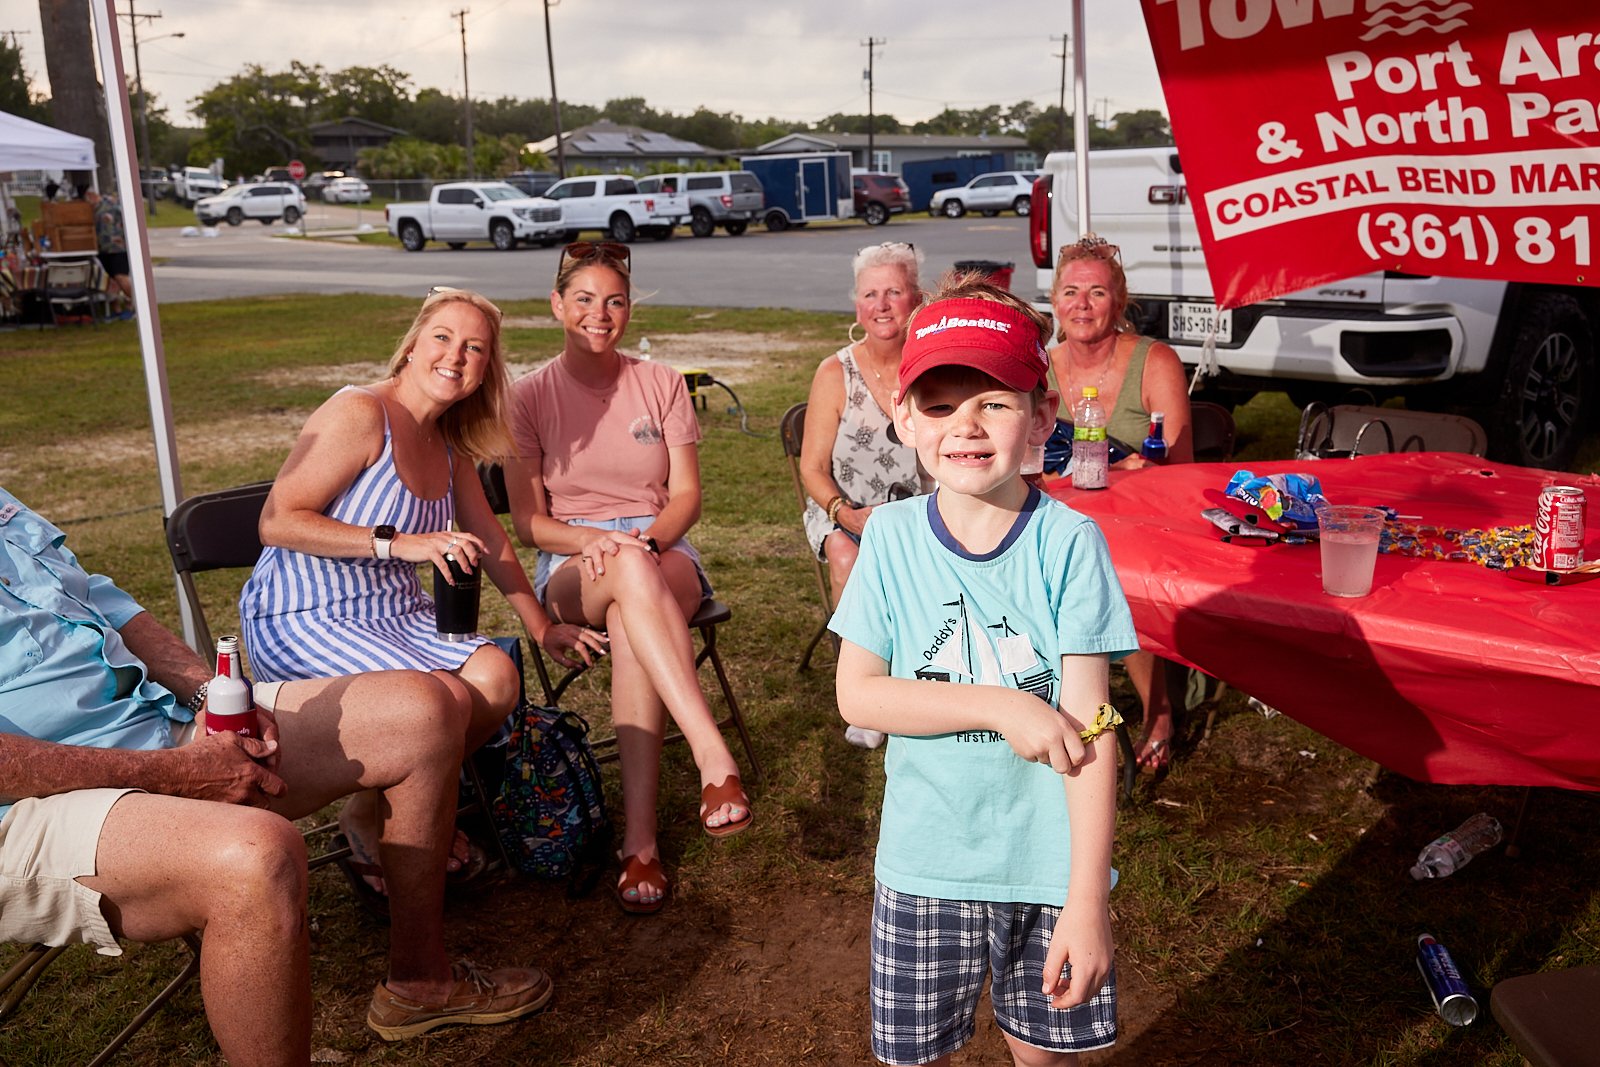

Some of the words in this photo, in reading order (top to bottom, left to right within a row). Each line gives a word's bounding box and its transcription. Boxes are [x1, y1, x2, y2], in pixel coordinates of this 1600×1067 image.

[1326, 41, 1481, 101] Port
[1499, 28, 1600, 85] Ar
[1256, 121, 1303, 164] &
[1315, 96, 1489, 153] North
[1507, 92, 1600, 138] Pa
[1216, 170, 1389, 225] COASTAL
[1396, 167, 1496, 195] BEND
[1357, 212, 1499, 265] (361)
[1513, 216, 1591, 266] 81
[1188, 306, 1212, 314] TEXAS
[923, 617, 957, 661] Daddy's
[956, 731, 986, 743] First
